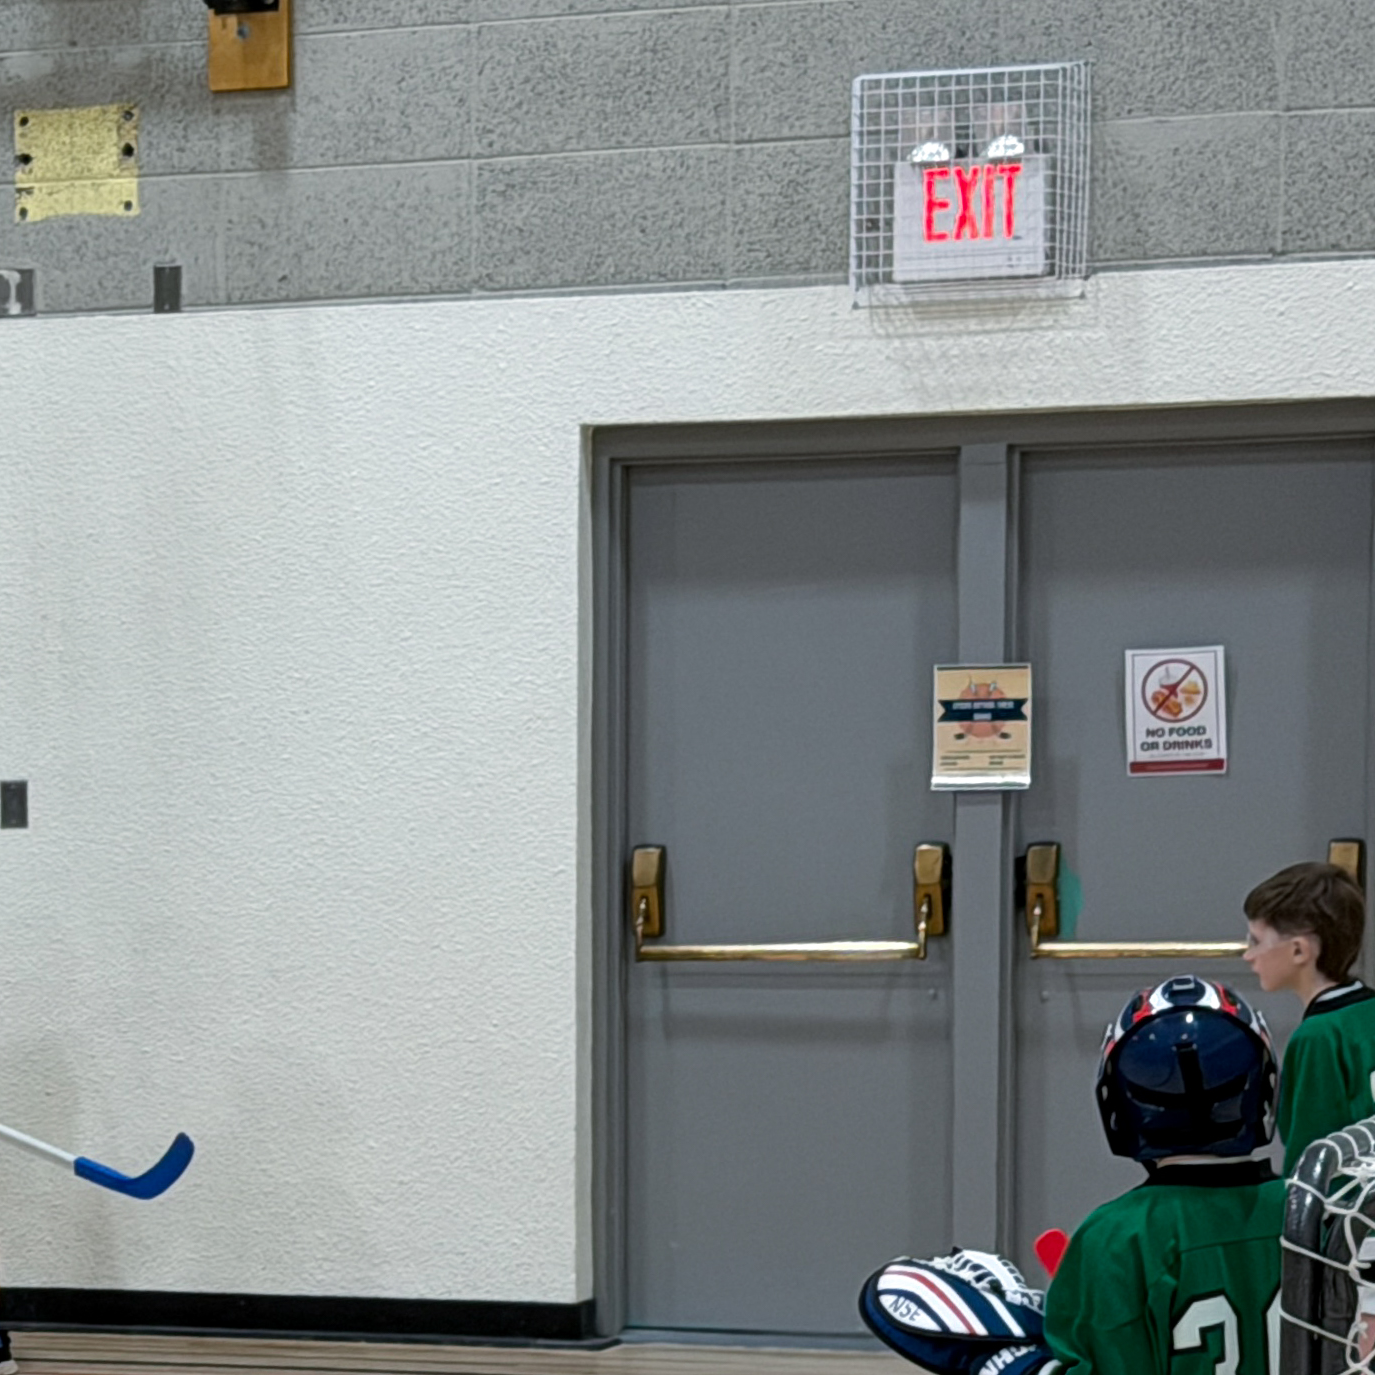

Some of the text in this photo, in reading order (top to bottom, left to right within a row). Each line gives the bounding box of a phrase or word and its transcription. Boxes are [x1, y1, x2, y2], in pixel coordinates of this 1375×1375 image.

[923, 164, 1023, 242] EXIT
[1146, 726, 1207, 738] NO FOOD
[1140, 739, 1213, 751] OR DRINKS
